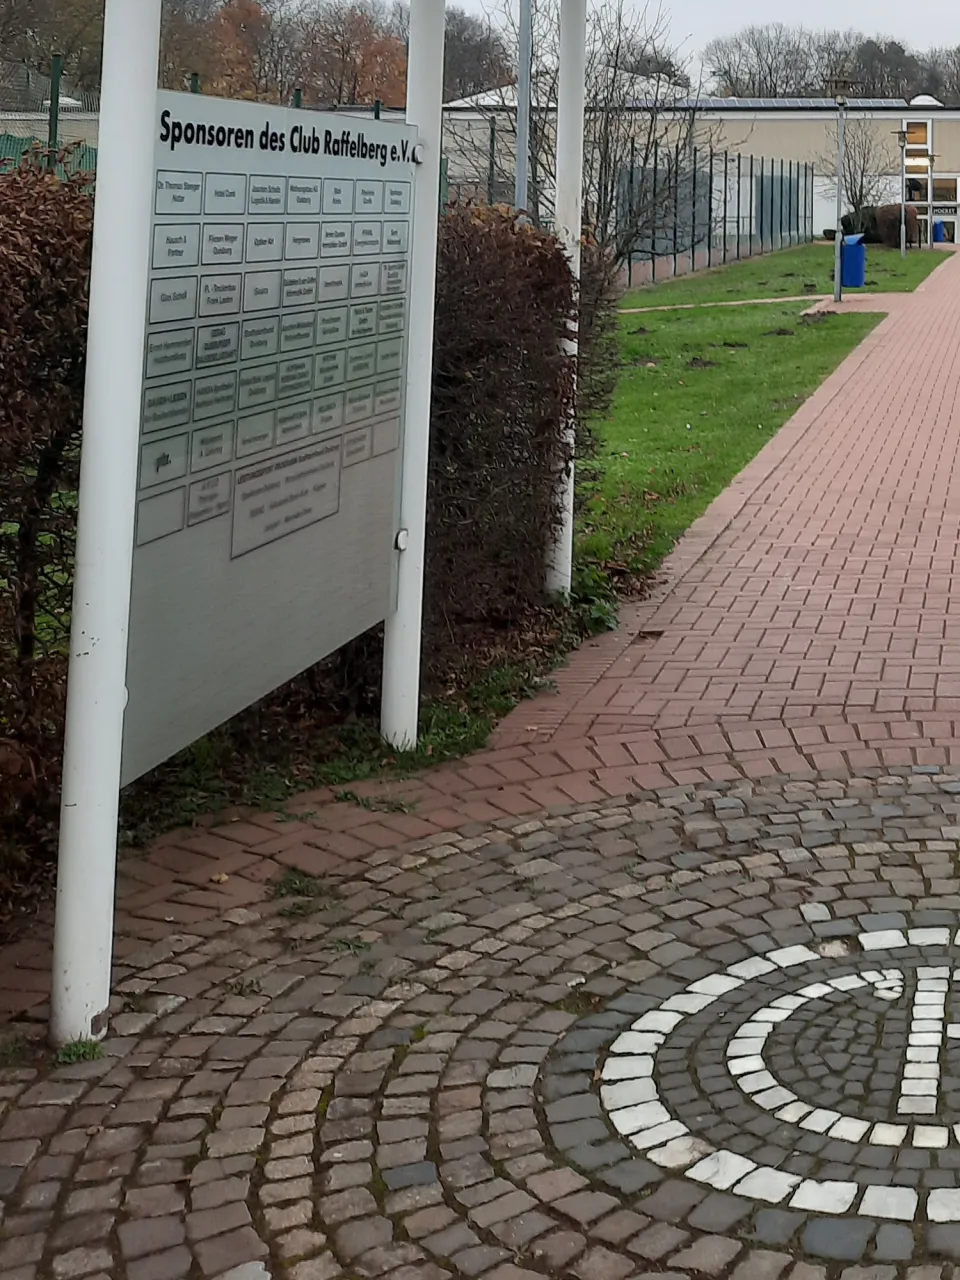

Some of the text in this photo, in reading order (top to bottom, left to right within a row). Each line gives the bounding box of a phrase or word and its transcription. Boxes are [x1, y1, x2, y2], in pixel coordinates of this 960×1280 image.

[160, 109, 254, 151] Sponsoren
[259, 121, 285, 152] des
[289, 125, 320, 154] Club
[324, 129, 387, 167] Raffelberg
